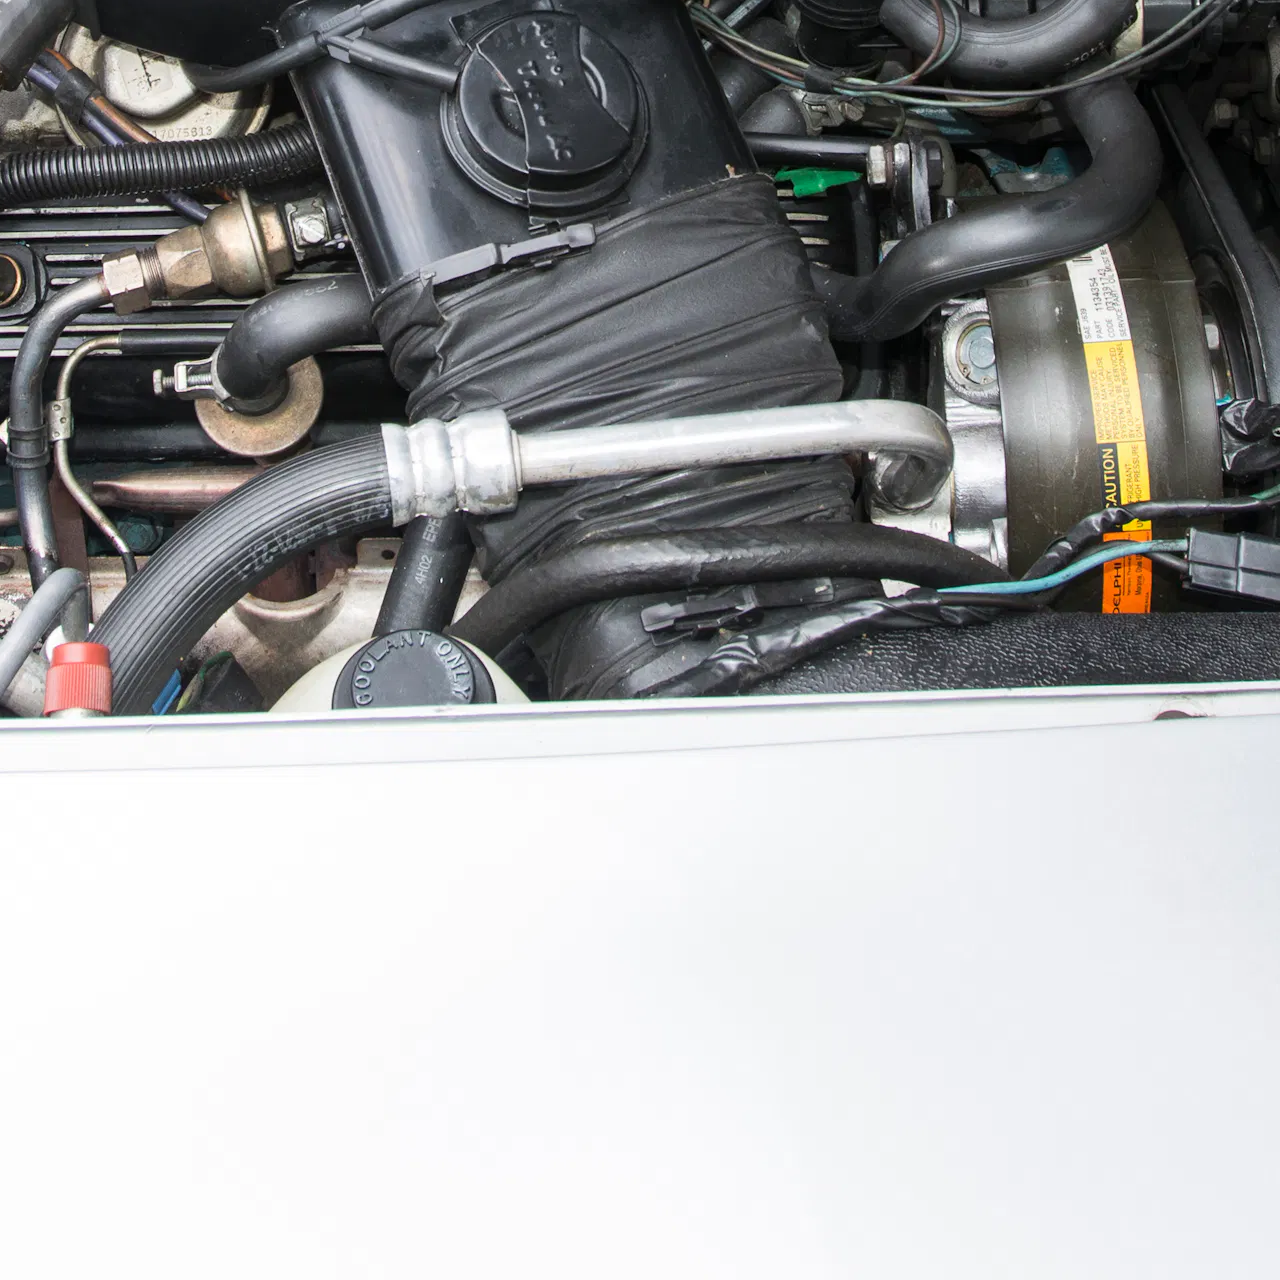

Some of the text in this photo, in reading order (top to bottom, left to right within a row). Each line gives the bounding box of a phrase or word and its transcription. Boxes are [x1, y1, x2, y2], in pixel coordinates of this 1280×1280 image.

[1102, 257, 1113, 272] MUST
[1089, 277, 1104, 339] PART 1134354
[1116, 308, 1126, 337] SERVICE
[1083, 325, 1091, 339] SAE
[1106, 319, 1115, 338] CODE
[1096, 357, 1105, 381] CAUSE
[1109, 347, 1120, 382] SERVICED
[1116, 342, 1128, 385] PERSONNEL
[1091, 370, 1104, 441] IMPROPER SERVICE
[1103, 403, 1112, 440] METHODS
[1111, 400, 1120, 440] PERSONAL
[1118, 408, 1128, 439] SYSTEM
[1123, 387, 1134, 426] QUALIFIED
[1131, 444, 1140, 484] PRESSURE
[1113, 563, 1122, 614] DELPHI
[354, 630, 471, 705] COOLANT ONLY
